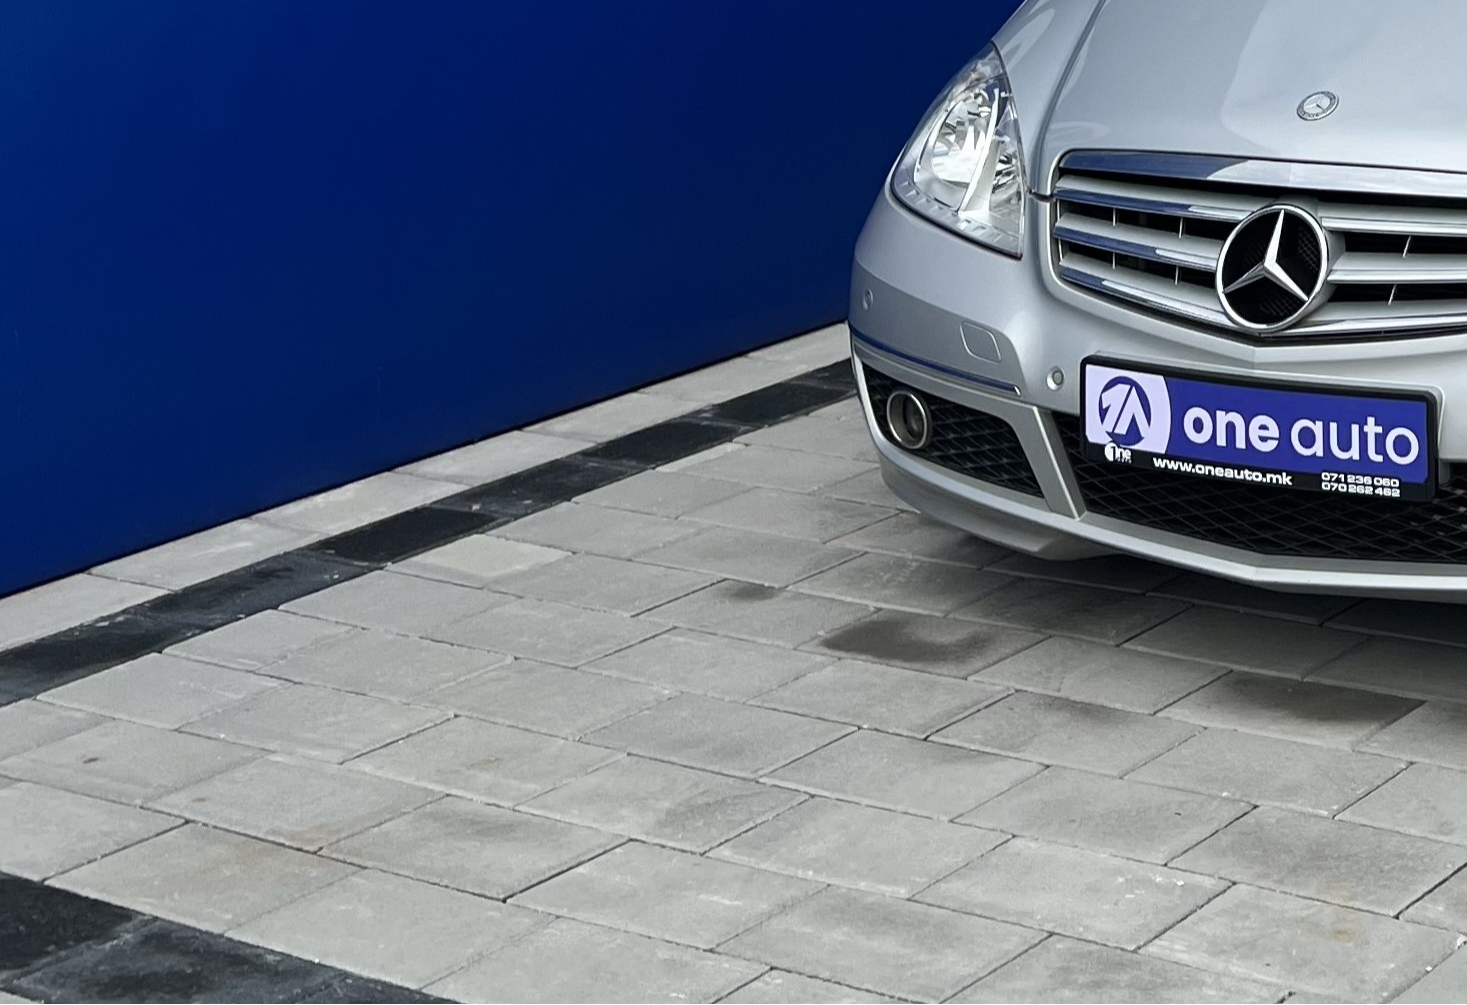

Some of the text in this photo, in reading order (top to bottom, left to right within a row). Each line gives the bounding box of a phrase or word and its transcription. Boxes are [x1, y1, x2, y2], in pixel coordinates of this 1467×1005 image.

[1183, 406, 1280, 452] one
[1290, 416, 1420, 465] auto
[1152, 457, 1293, 485] www.oneauto.mk
[1321, 472, 1345, 482] 071
[1321, 481, 1347, 492] 070
